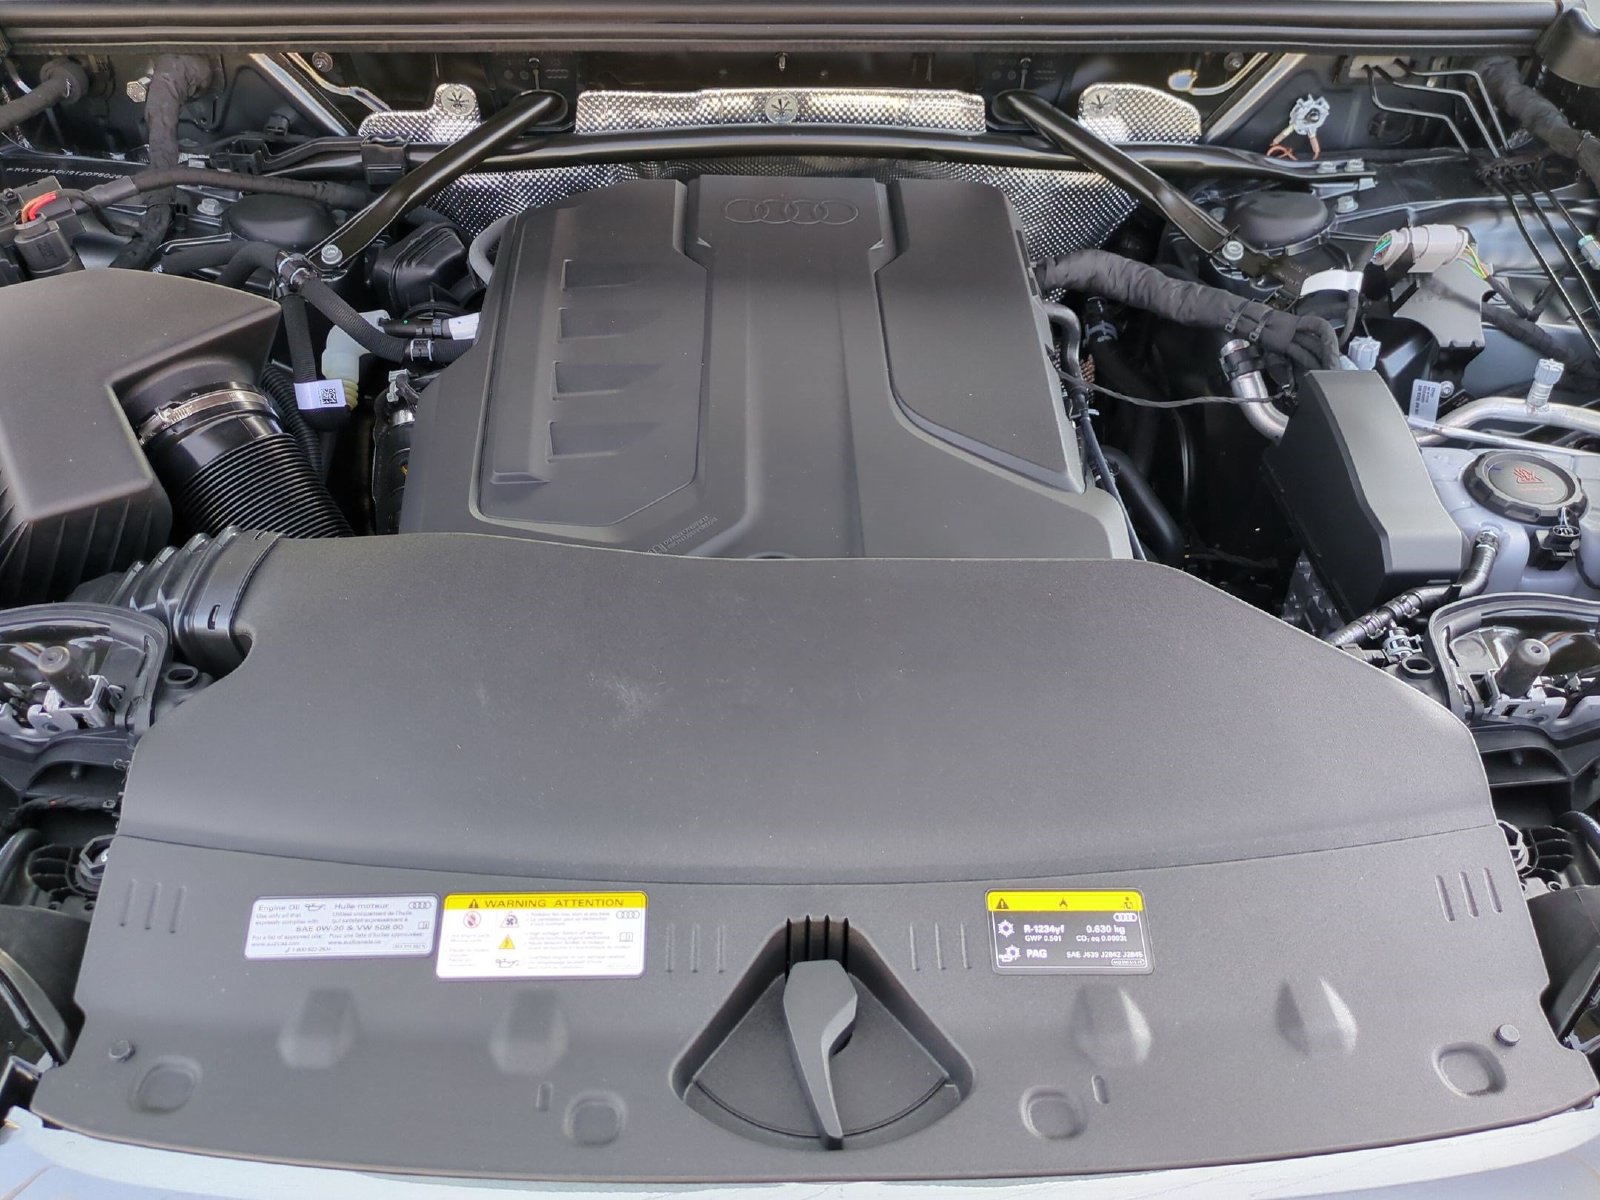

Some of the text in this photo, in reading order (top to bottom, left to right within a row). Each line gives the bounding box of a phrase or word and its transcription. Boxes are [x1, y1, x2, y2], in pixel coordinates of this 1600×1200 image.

[258, 903, 300, 912] Engine Oil
[334, 902, 356, 910] Huile
[484, 898, 624, 908] WARNING ATTENTION
[1023, 924, 1126, 936] R-1234yf 0.630 kg
[1024, 935, 1042, 943] GWP
[1044, 935, 1062, 943] 0.501
[1026, 949, 1047, 959] PAG
